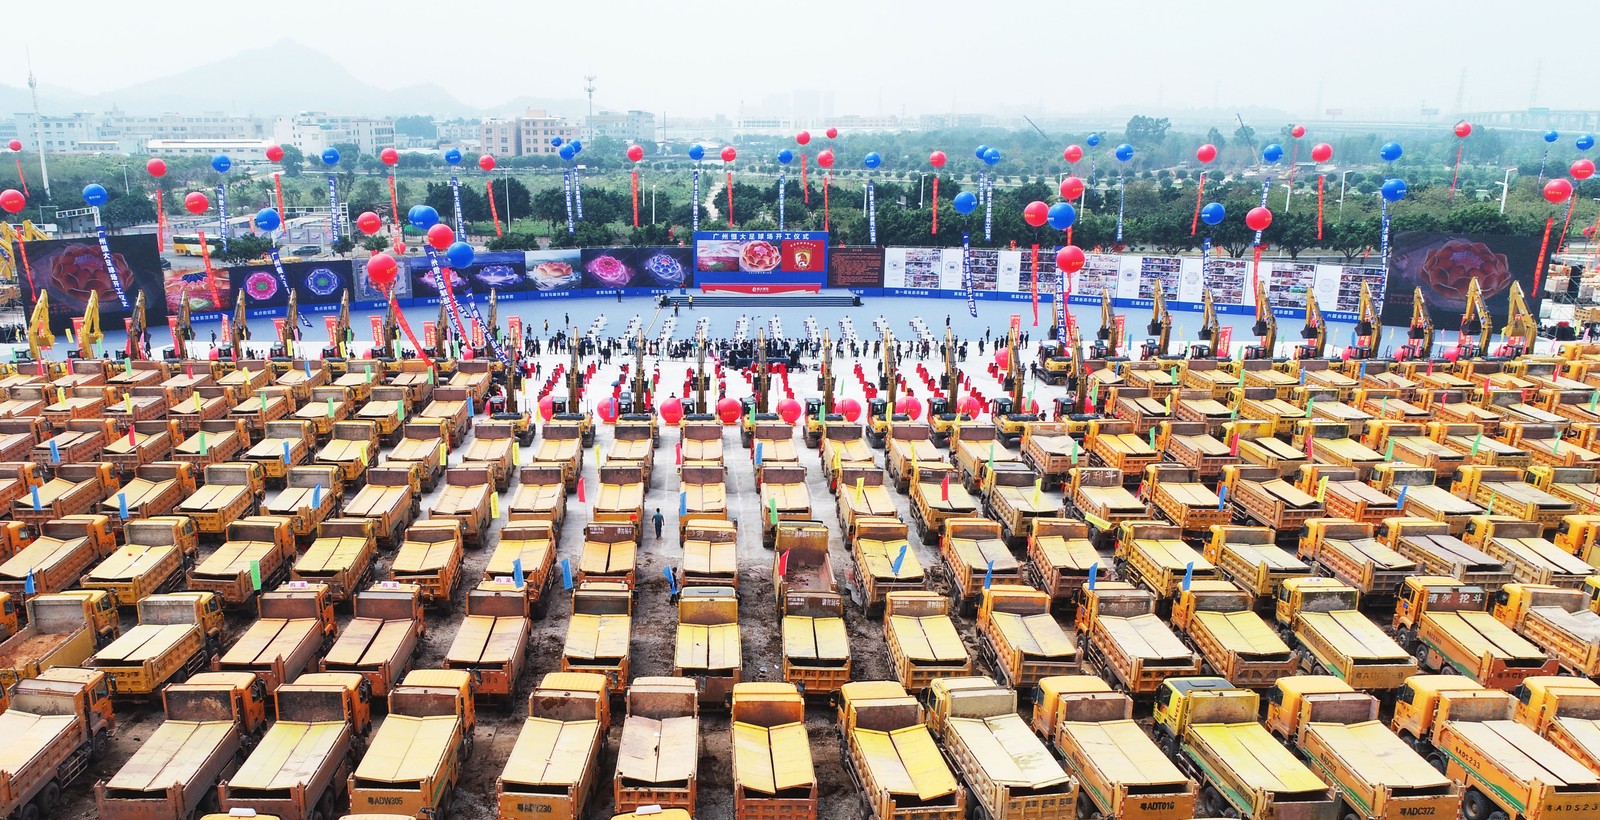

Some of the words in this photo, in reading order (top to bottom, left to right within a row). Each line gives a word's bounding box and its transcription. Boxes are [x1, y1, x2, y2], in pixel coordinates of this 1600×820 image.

[1428, 593, 1483, 604] 请勿挖斗
[1400, 806, 1436, 816] 粤ADC372
